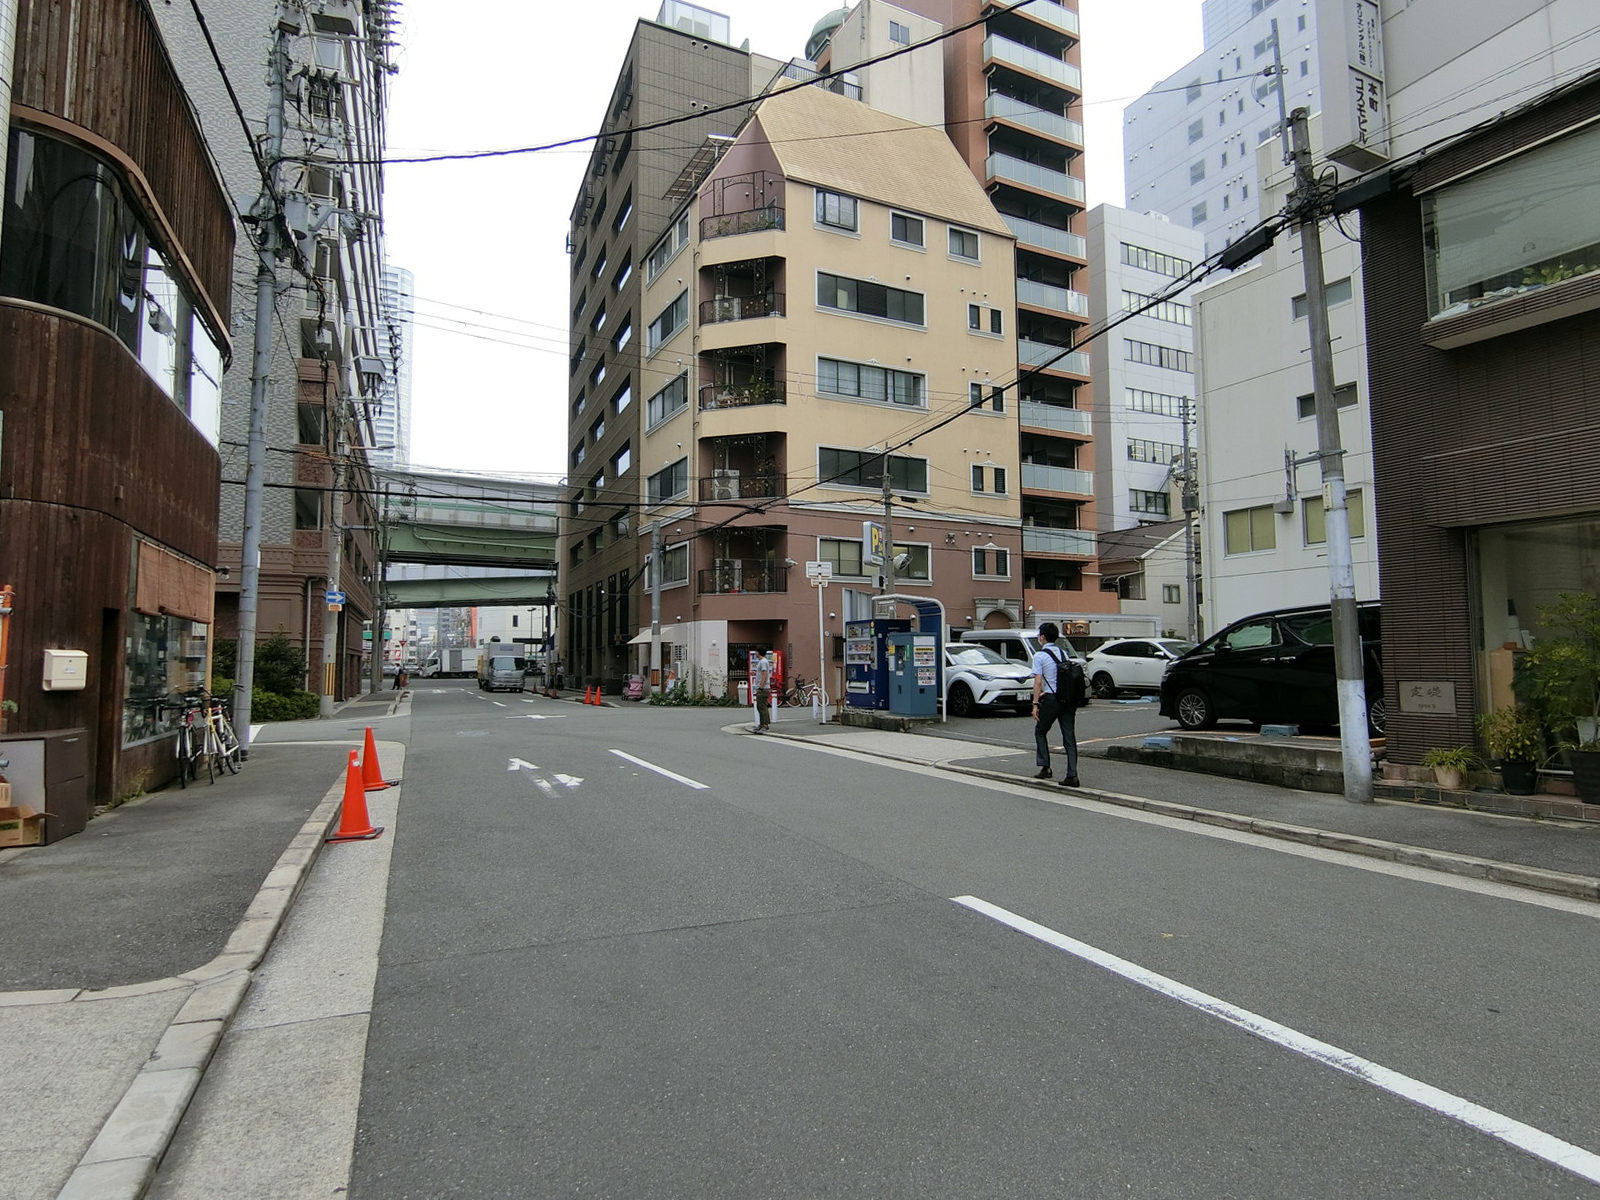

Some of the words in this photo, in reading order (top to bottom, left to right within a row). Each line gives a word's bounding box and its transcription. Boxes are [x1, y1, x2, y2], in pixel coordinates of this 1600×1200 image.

[1355, 77, 1368, 144] コスモビル
[1368, 82, 1378, 112] 本町
[871, 526, 879, 553] P
